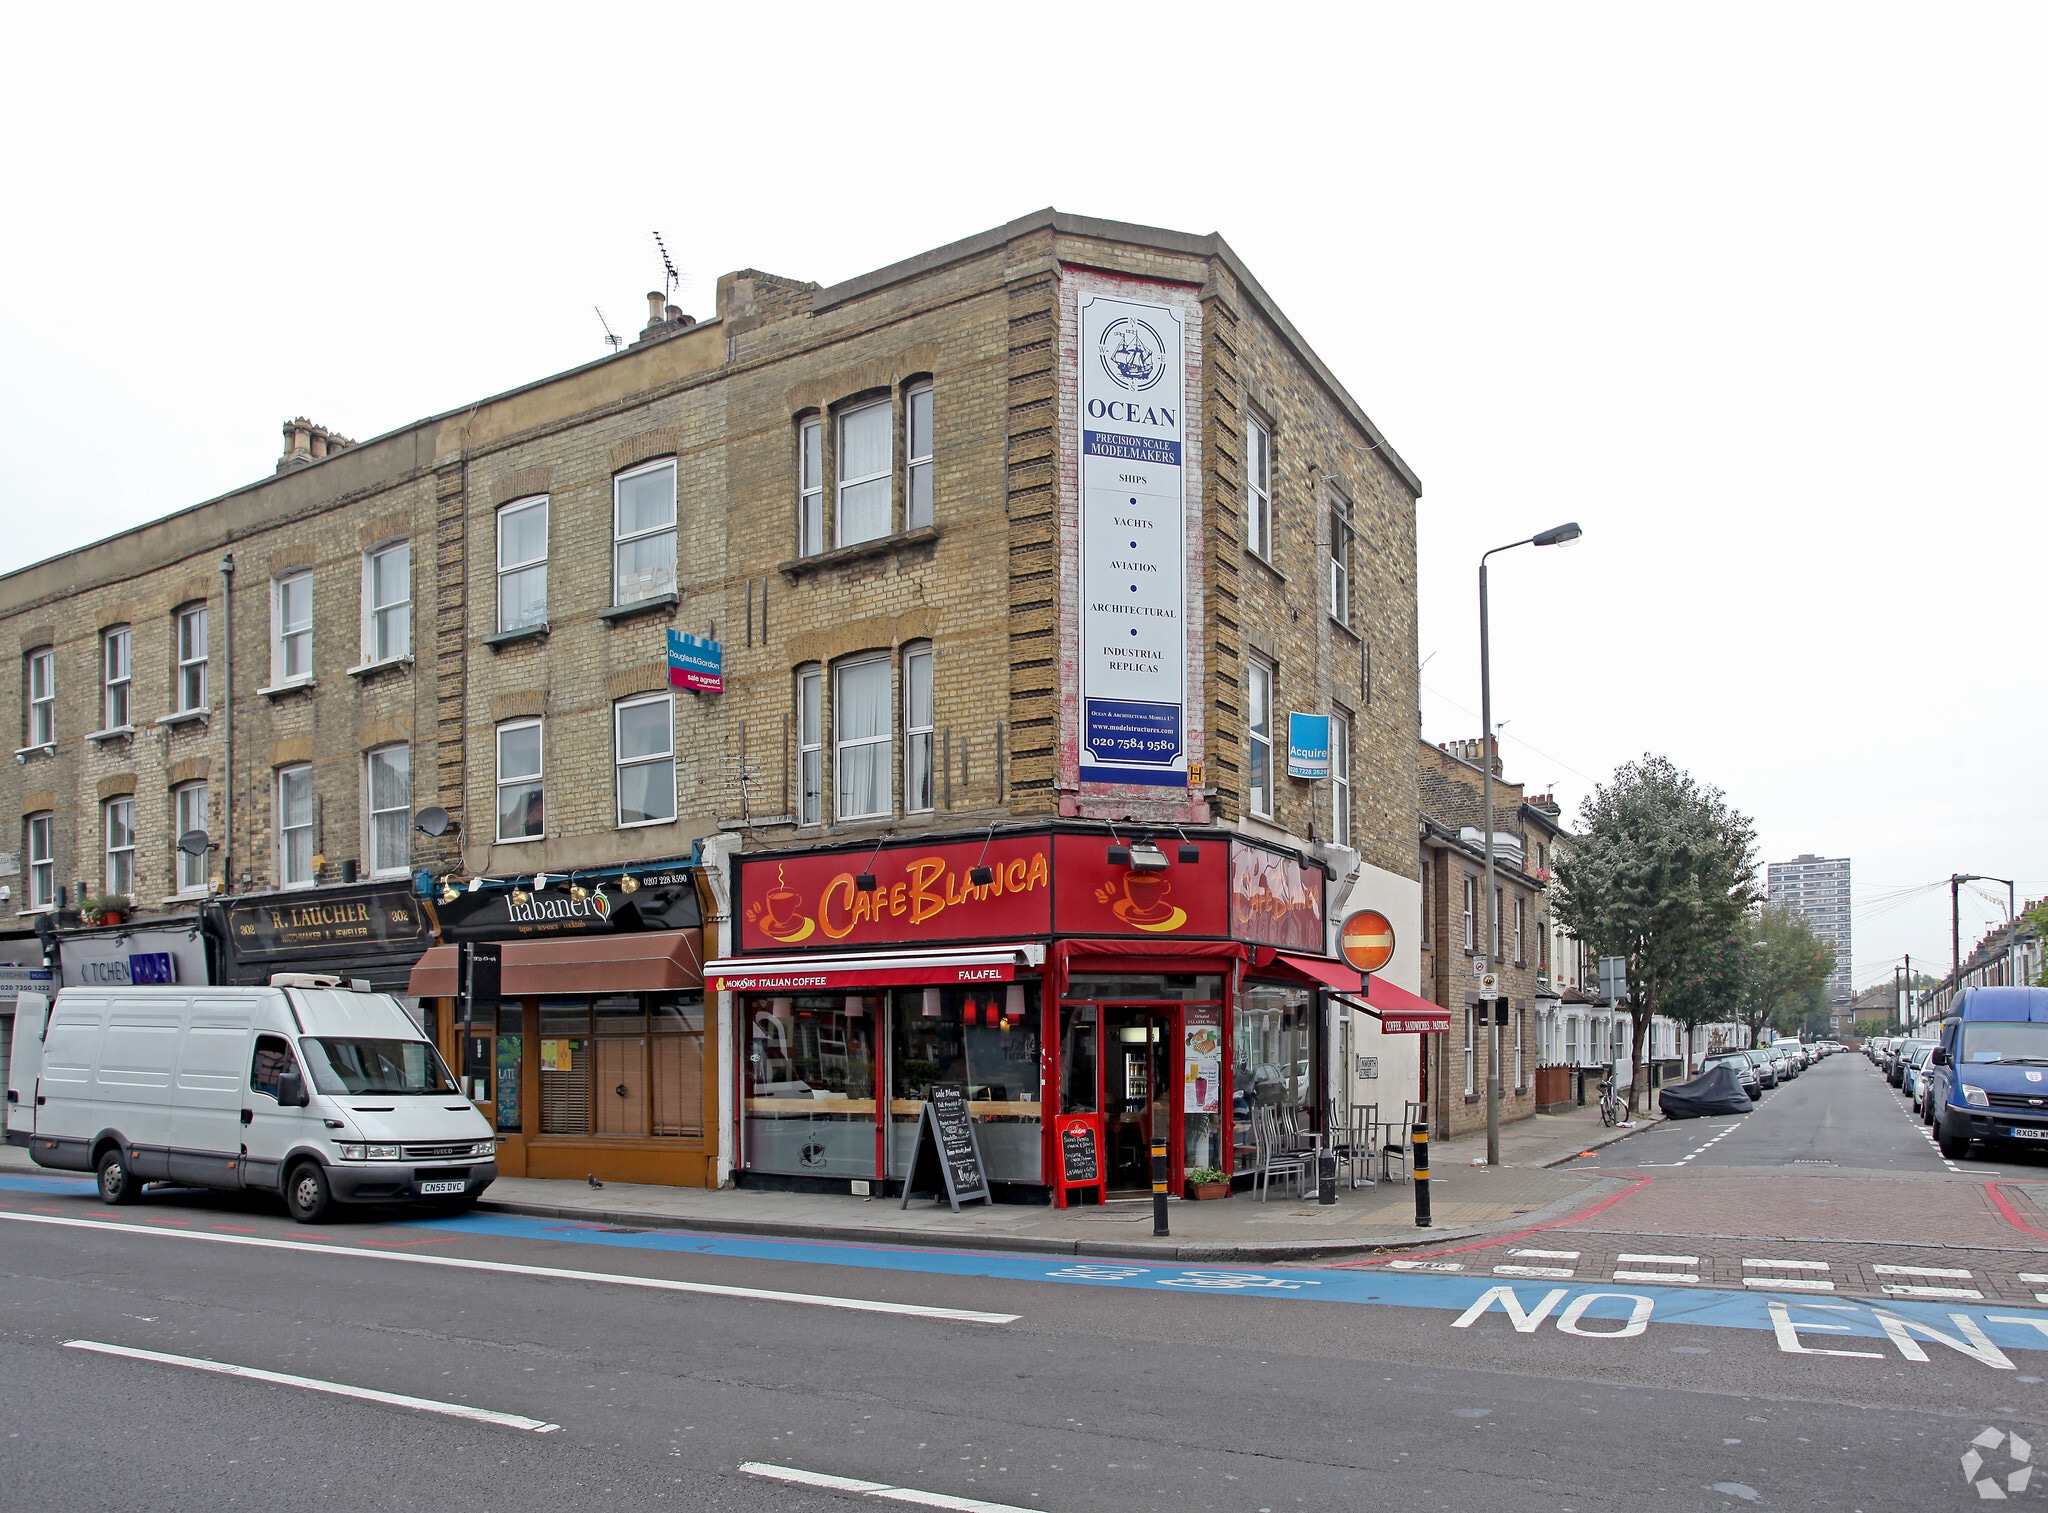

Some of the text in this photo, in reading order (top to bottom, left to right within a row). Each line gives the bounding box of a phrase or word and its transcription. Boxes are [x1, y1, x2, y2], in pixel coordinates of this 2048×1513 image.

[1088, 398, 1176, 428] OCEAN
[1096, 432, 1170, 451] PRECISION SCALE
[1091, 442, 1175, 464] MODELMAKERS
[1118, 473, 1147, 485] SHIPS
[1113, 516, 1154, 530] YACHTS
[1109, 560, 1158, 573] AVIATION
[1090, 602, 1177, 618] ARCHITECTURAL
[669, 649, 720, 669] Douglas&Gordon
[1103, 646, 1164, 660] INDUSTRIAL
[1109, 660, 1160, 674] REPLICAS
[687, 674, 720, 685] sale agreed
[1113, 711, 1148, 720] ARCHITECTURAL
[1092, 723, 1174, 735] www.modelstructures.com
[1092, 737, 1175, 752] 020 7584 9580
[1290, 745, 1328, 759] Acquire
[643, 874, 688, 886] 0207 228 8590
[818, 852, 1048, 939] CAFE BLANCA
[504, 884, 611, 923] habanero
[271, 903, 371, 929] R. LAUCHER
[391, 910, 409, 923] 302
[240, 924, 256, 936] 302
[281, 927, 368, 943] WATCHMAKER & JEWELLER
[758, 977, 791, 988] ITALIAN
[792, 976, 827, 987] COFFEE
[958, 969, 1002, 981] FALAFEL
[1386, 1020, 1402, 1032] COFFEE
[1404, 1020, 1430, 1031] SANDWICHES
[2016, 1129, 2039, 1138] RX05
[424, 1182, 462, 1192] CN55 DVC
[1451, 1286, 1655, 1339] NO
